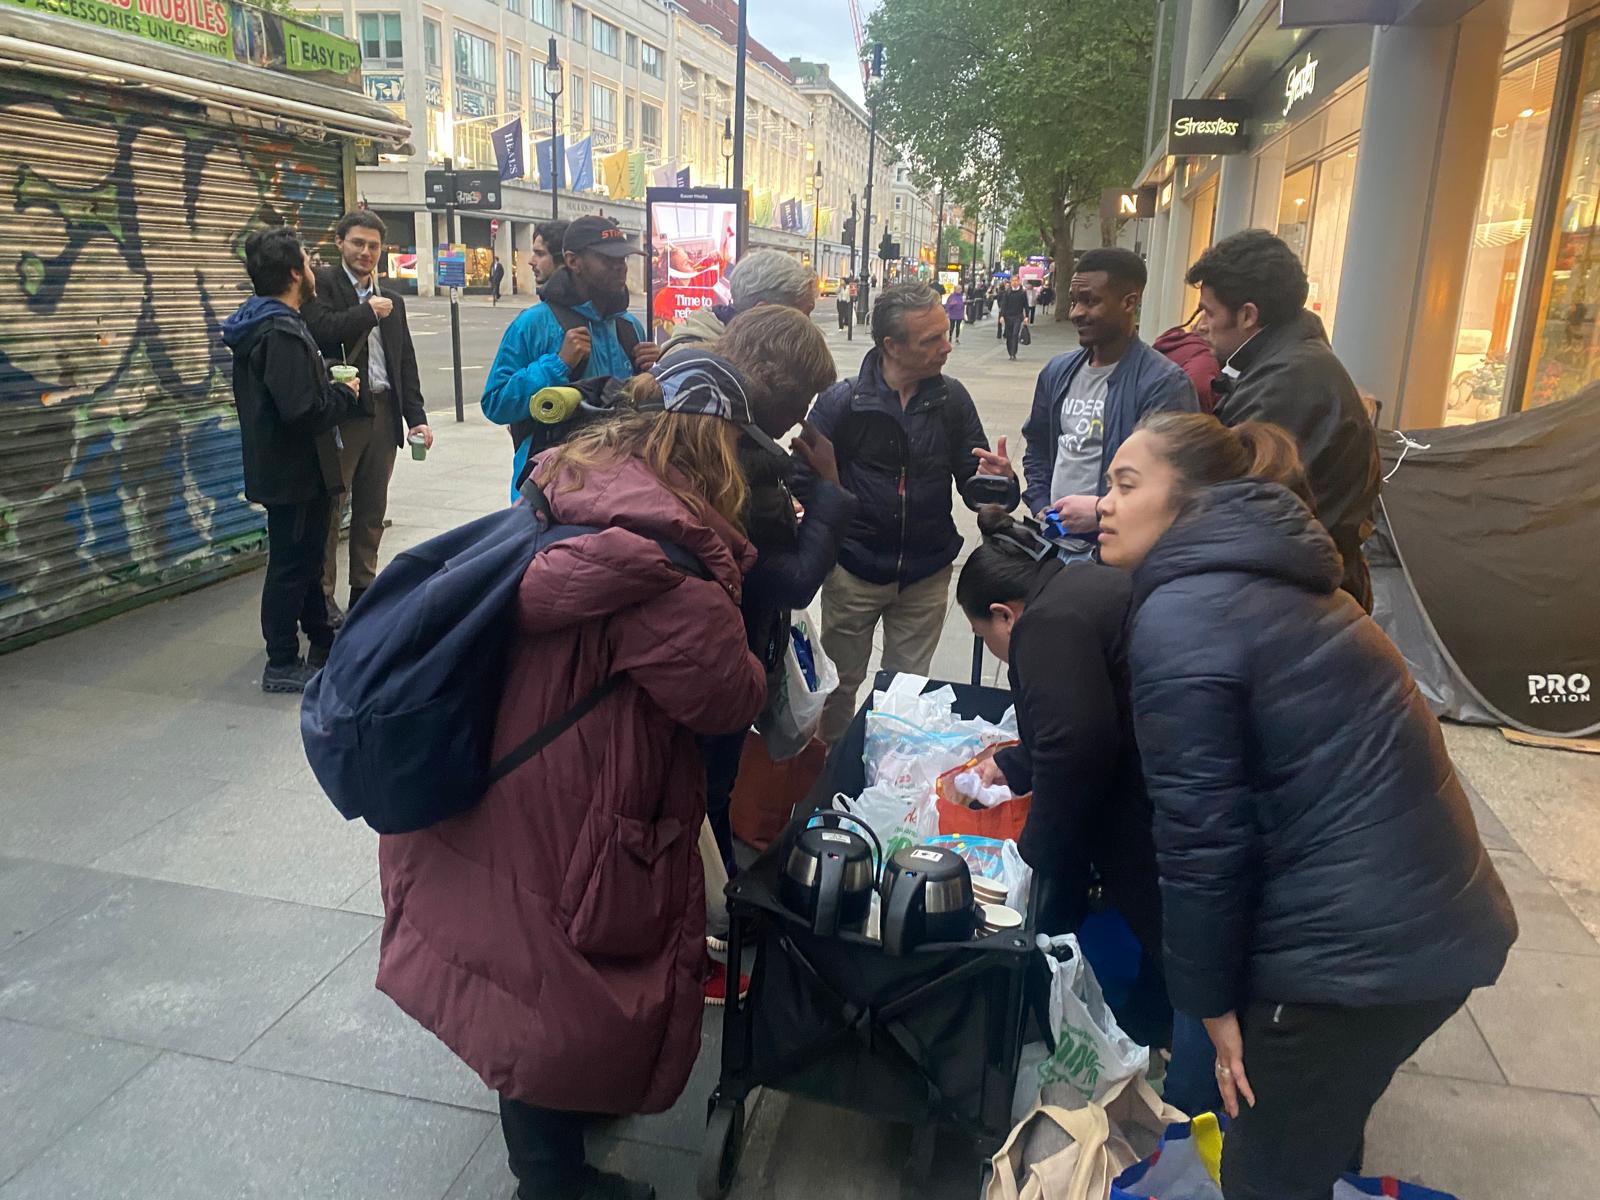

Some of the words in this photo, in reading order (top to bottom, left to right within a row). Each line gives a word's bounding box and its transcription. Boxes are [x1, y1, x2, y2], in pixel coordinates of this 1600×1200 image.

[138, 0, 227, 36] MOBILES
[301, 41, 334, 68] EASY
[1174, 117, 1239, 137] Stressless
[1120, 194, 1138, 214] N
[674, 294, 700, 307] Time
[701, 295, 713, 307] to
[1061, 398, 1105, 417] NDER
[1528, 673, 1591, 696] PRO
[1530, 694, 1591, 704] ACTION
